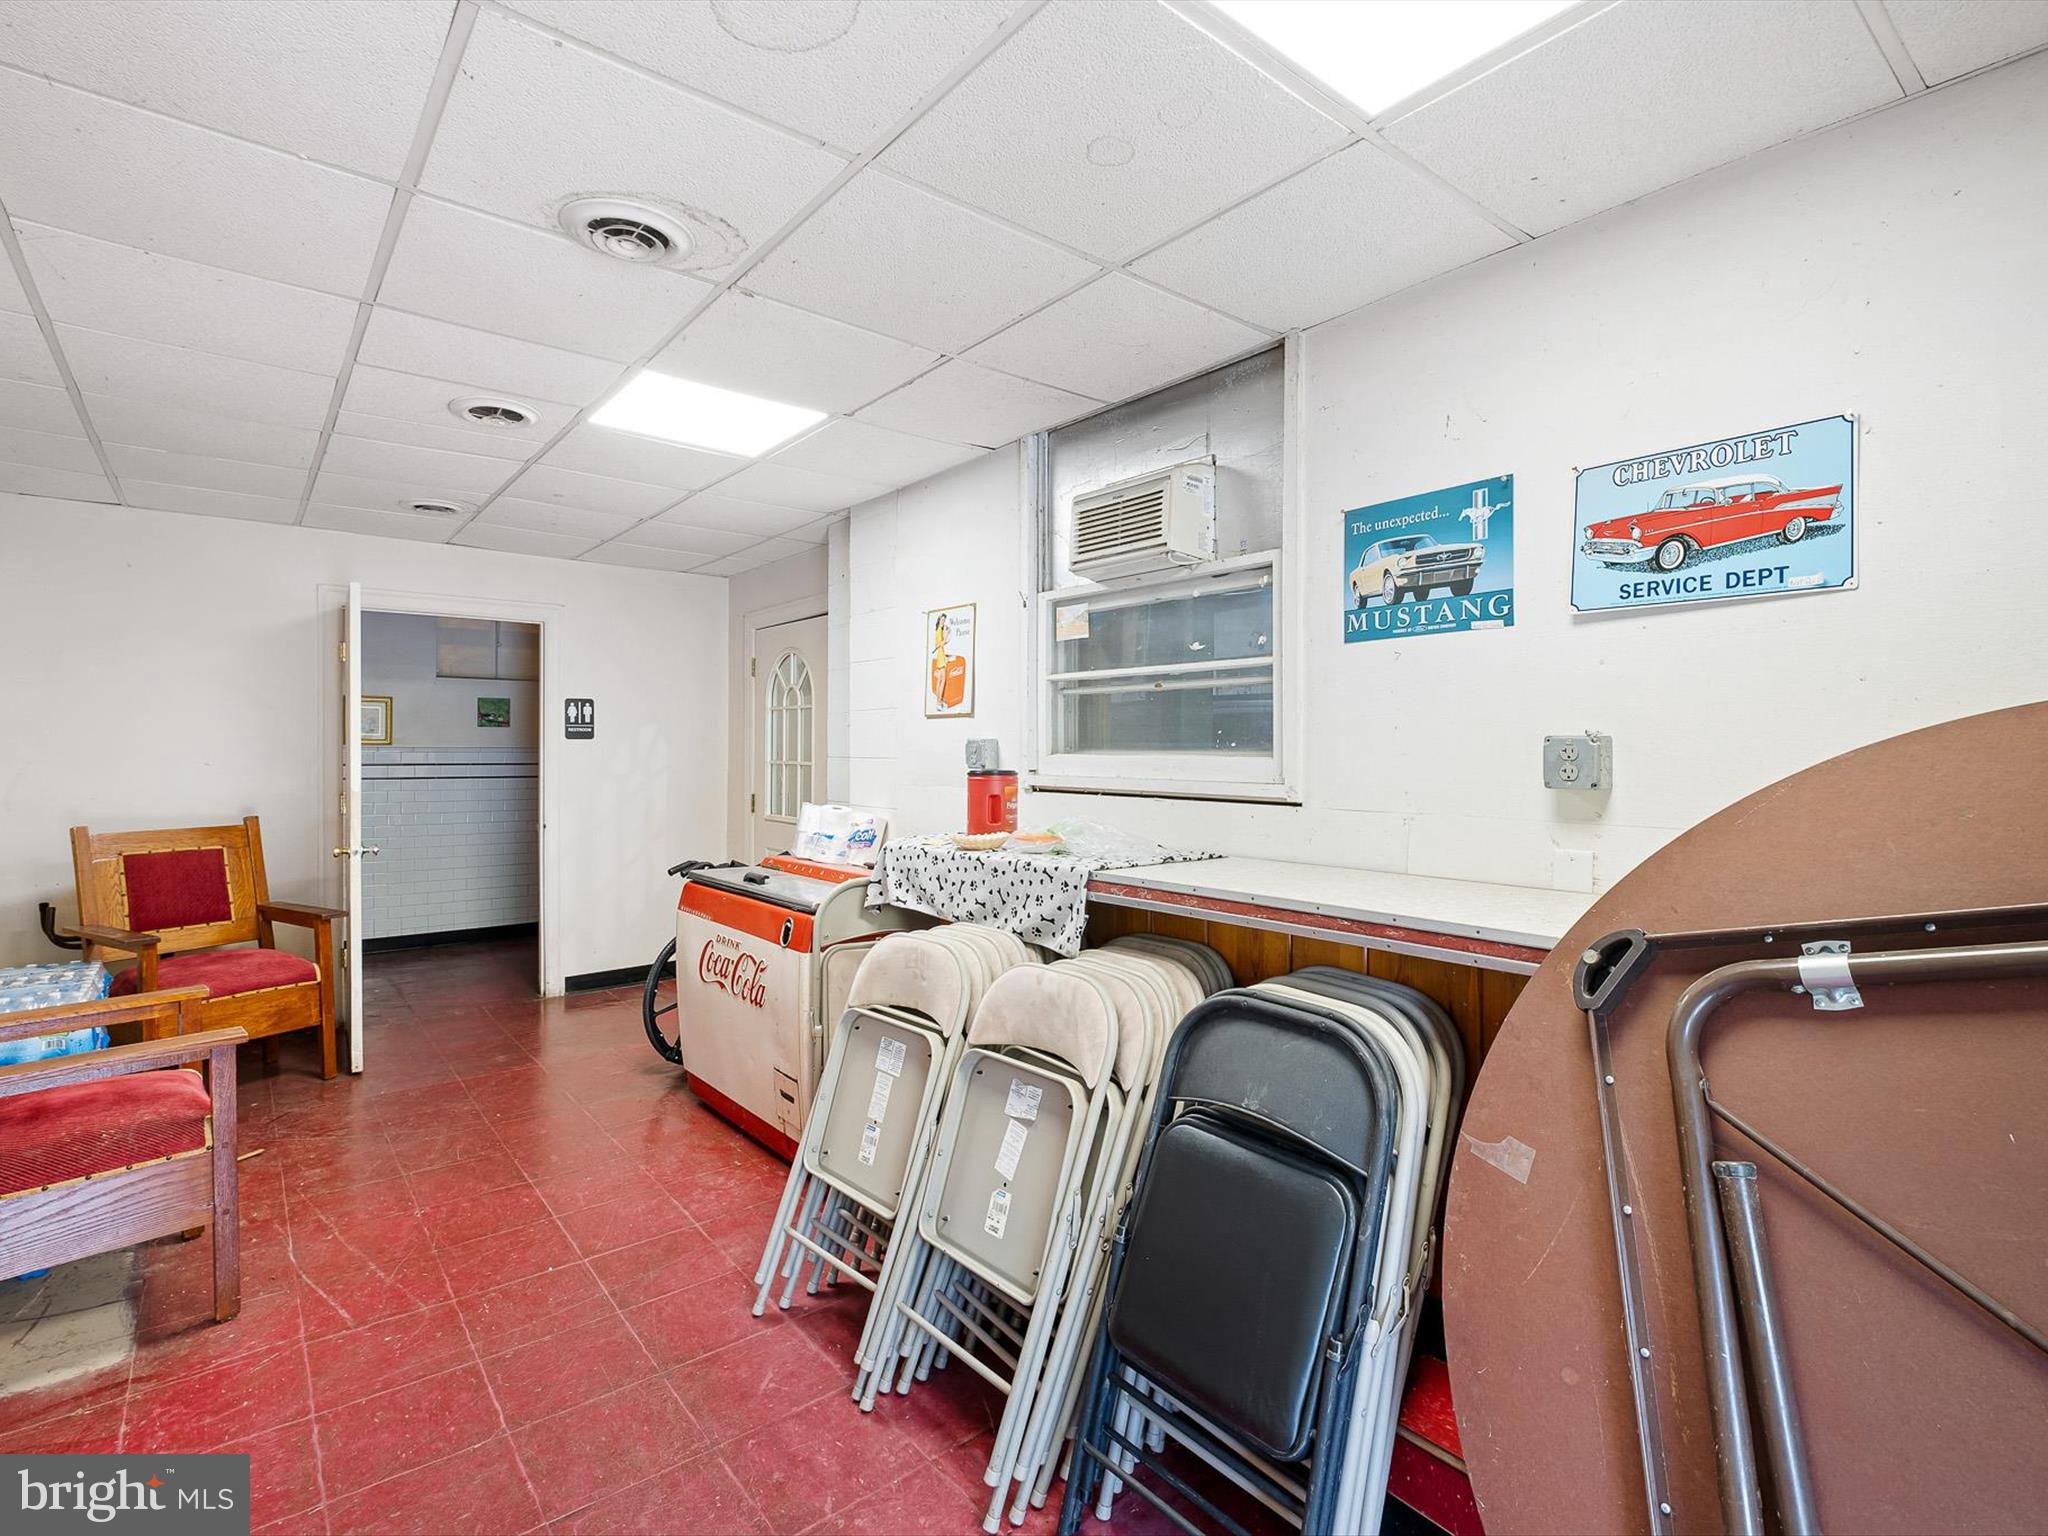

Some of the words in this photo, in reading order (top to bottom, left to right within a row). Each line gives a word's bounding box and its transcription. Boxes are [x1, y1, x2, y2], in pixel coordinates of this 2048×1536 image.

[1612, 429, 1799, 487] CHEVROLET
[1351, 522, 1373, 536] The
[1375, 505, 1450, 530] unexpected...
[1619, 574, 1713, 600] SERVICE
[1725, 566, 1790, 589] DEPT
[1347, 594, 1511, 633] MUSTANG
[716, 934, 742, 951] DRINK
